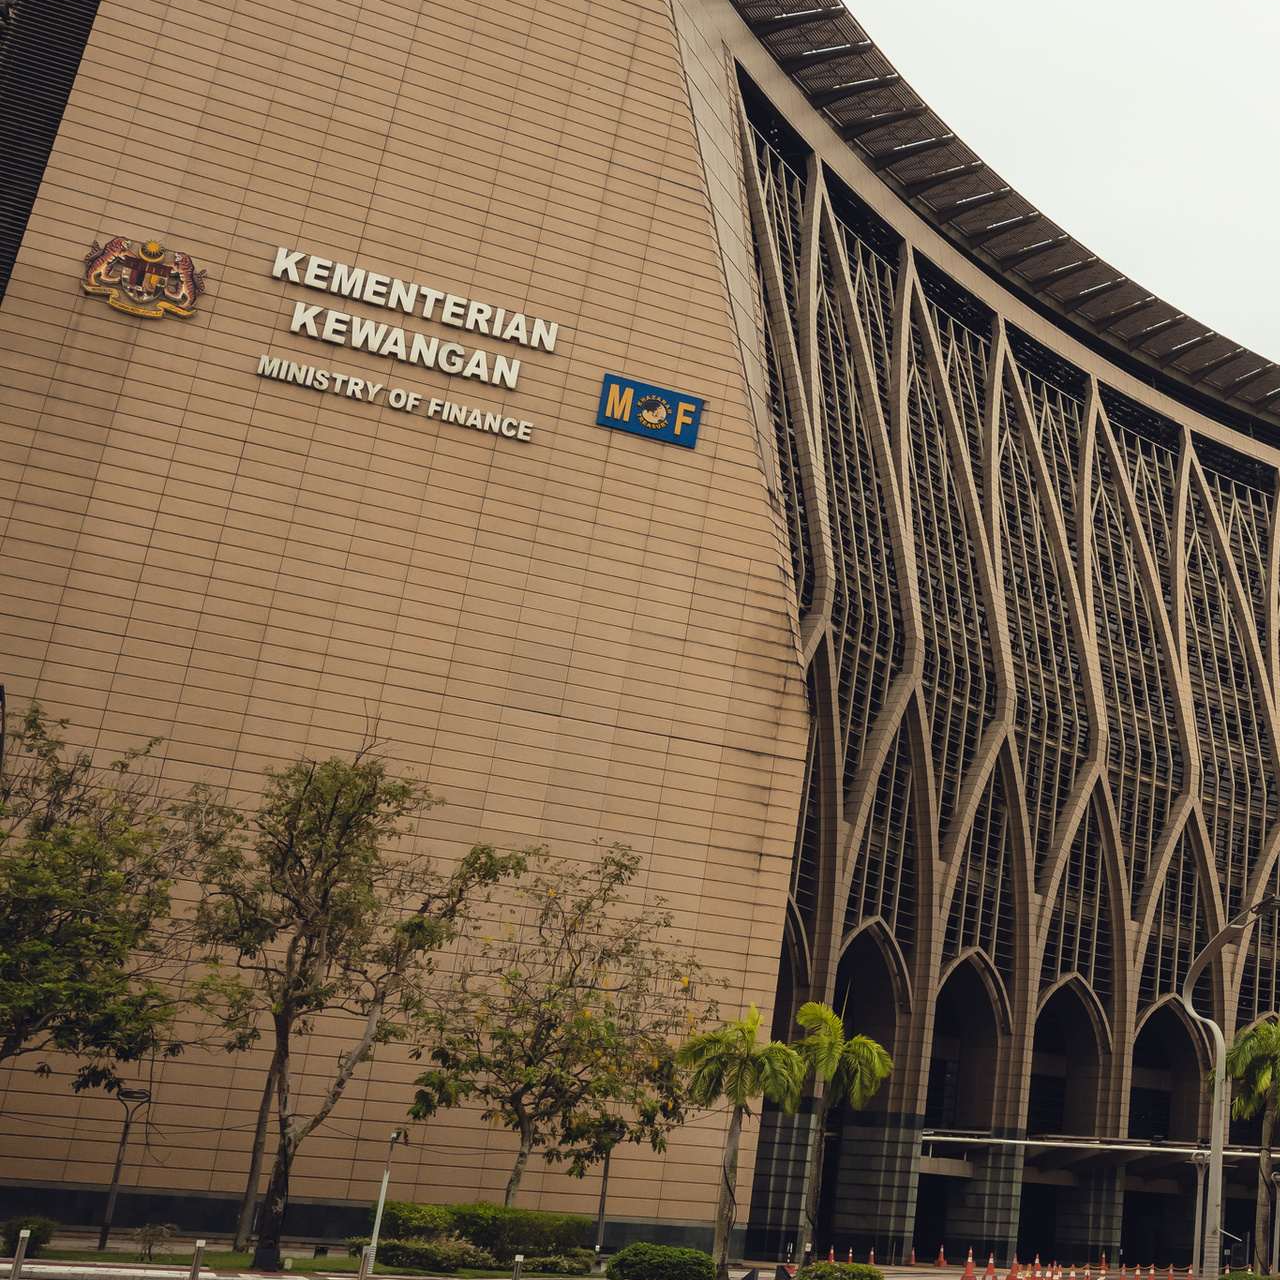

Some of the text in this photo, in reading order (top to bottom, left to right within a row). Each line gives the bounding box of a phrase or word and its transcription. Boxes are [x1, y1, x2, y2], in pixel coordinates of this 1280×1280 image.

[272, 246, 559, 352] KEMENTERIAN
[290, 301, 521, 389] KEWANGAN
[257, 354, 534, 442] MINISTRY OF FINANCE
[637, 395, 672, 414] KHAZANAH
[637, 413, 669, 429] TREASURY
